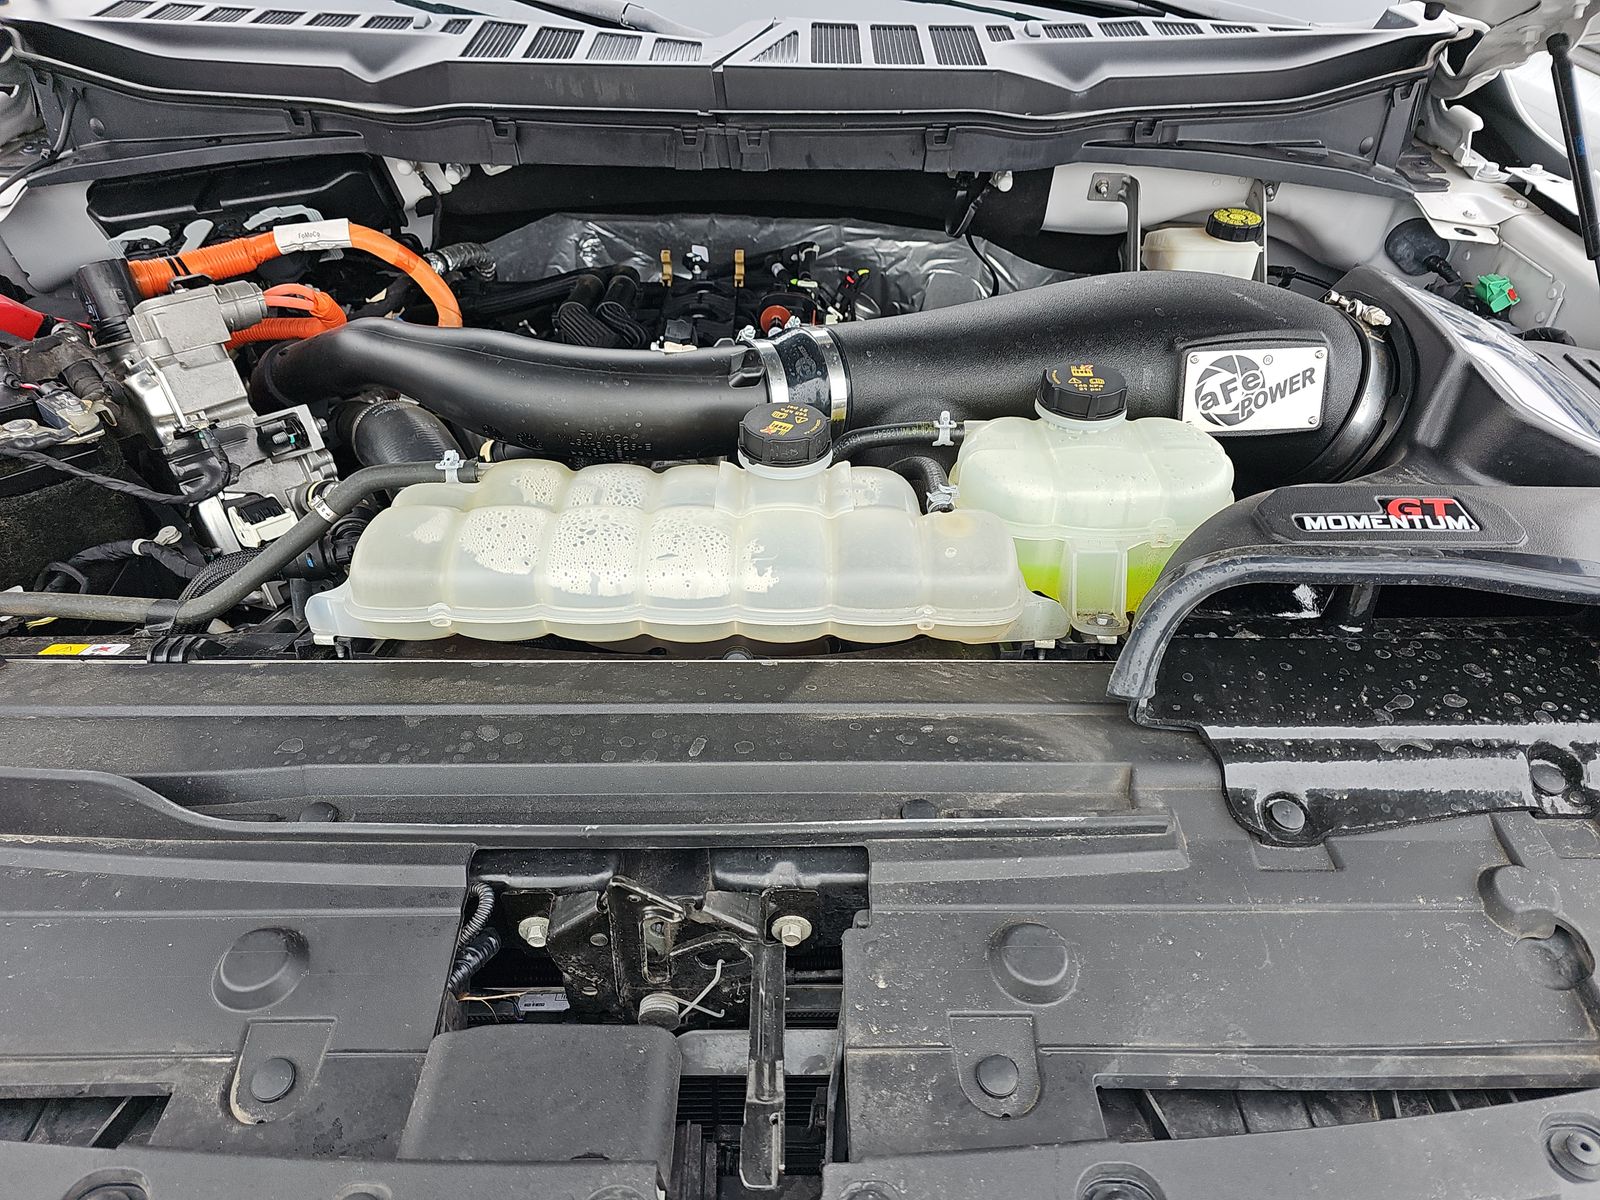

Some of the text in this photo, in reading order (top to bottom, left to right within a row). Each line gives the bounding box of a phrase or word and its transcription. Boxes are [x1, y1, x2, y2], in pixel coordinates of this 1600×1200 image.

[1200, 372, 1261, 411] aFe
[1240, 367, 1316, 418] POWER
[1303, 515, 1473, 530] MOMENTUM
[1387, 497, 1455, 519] GT
